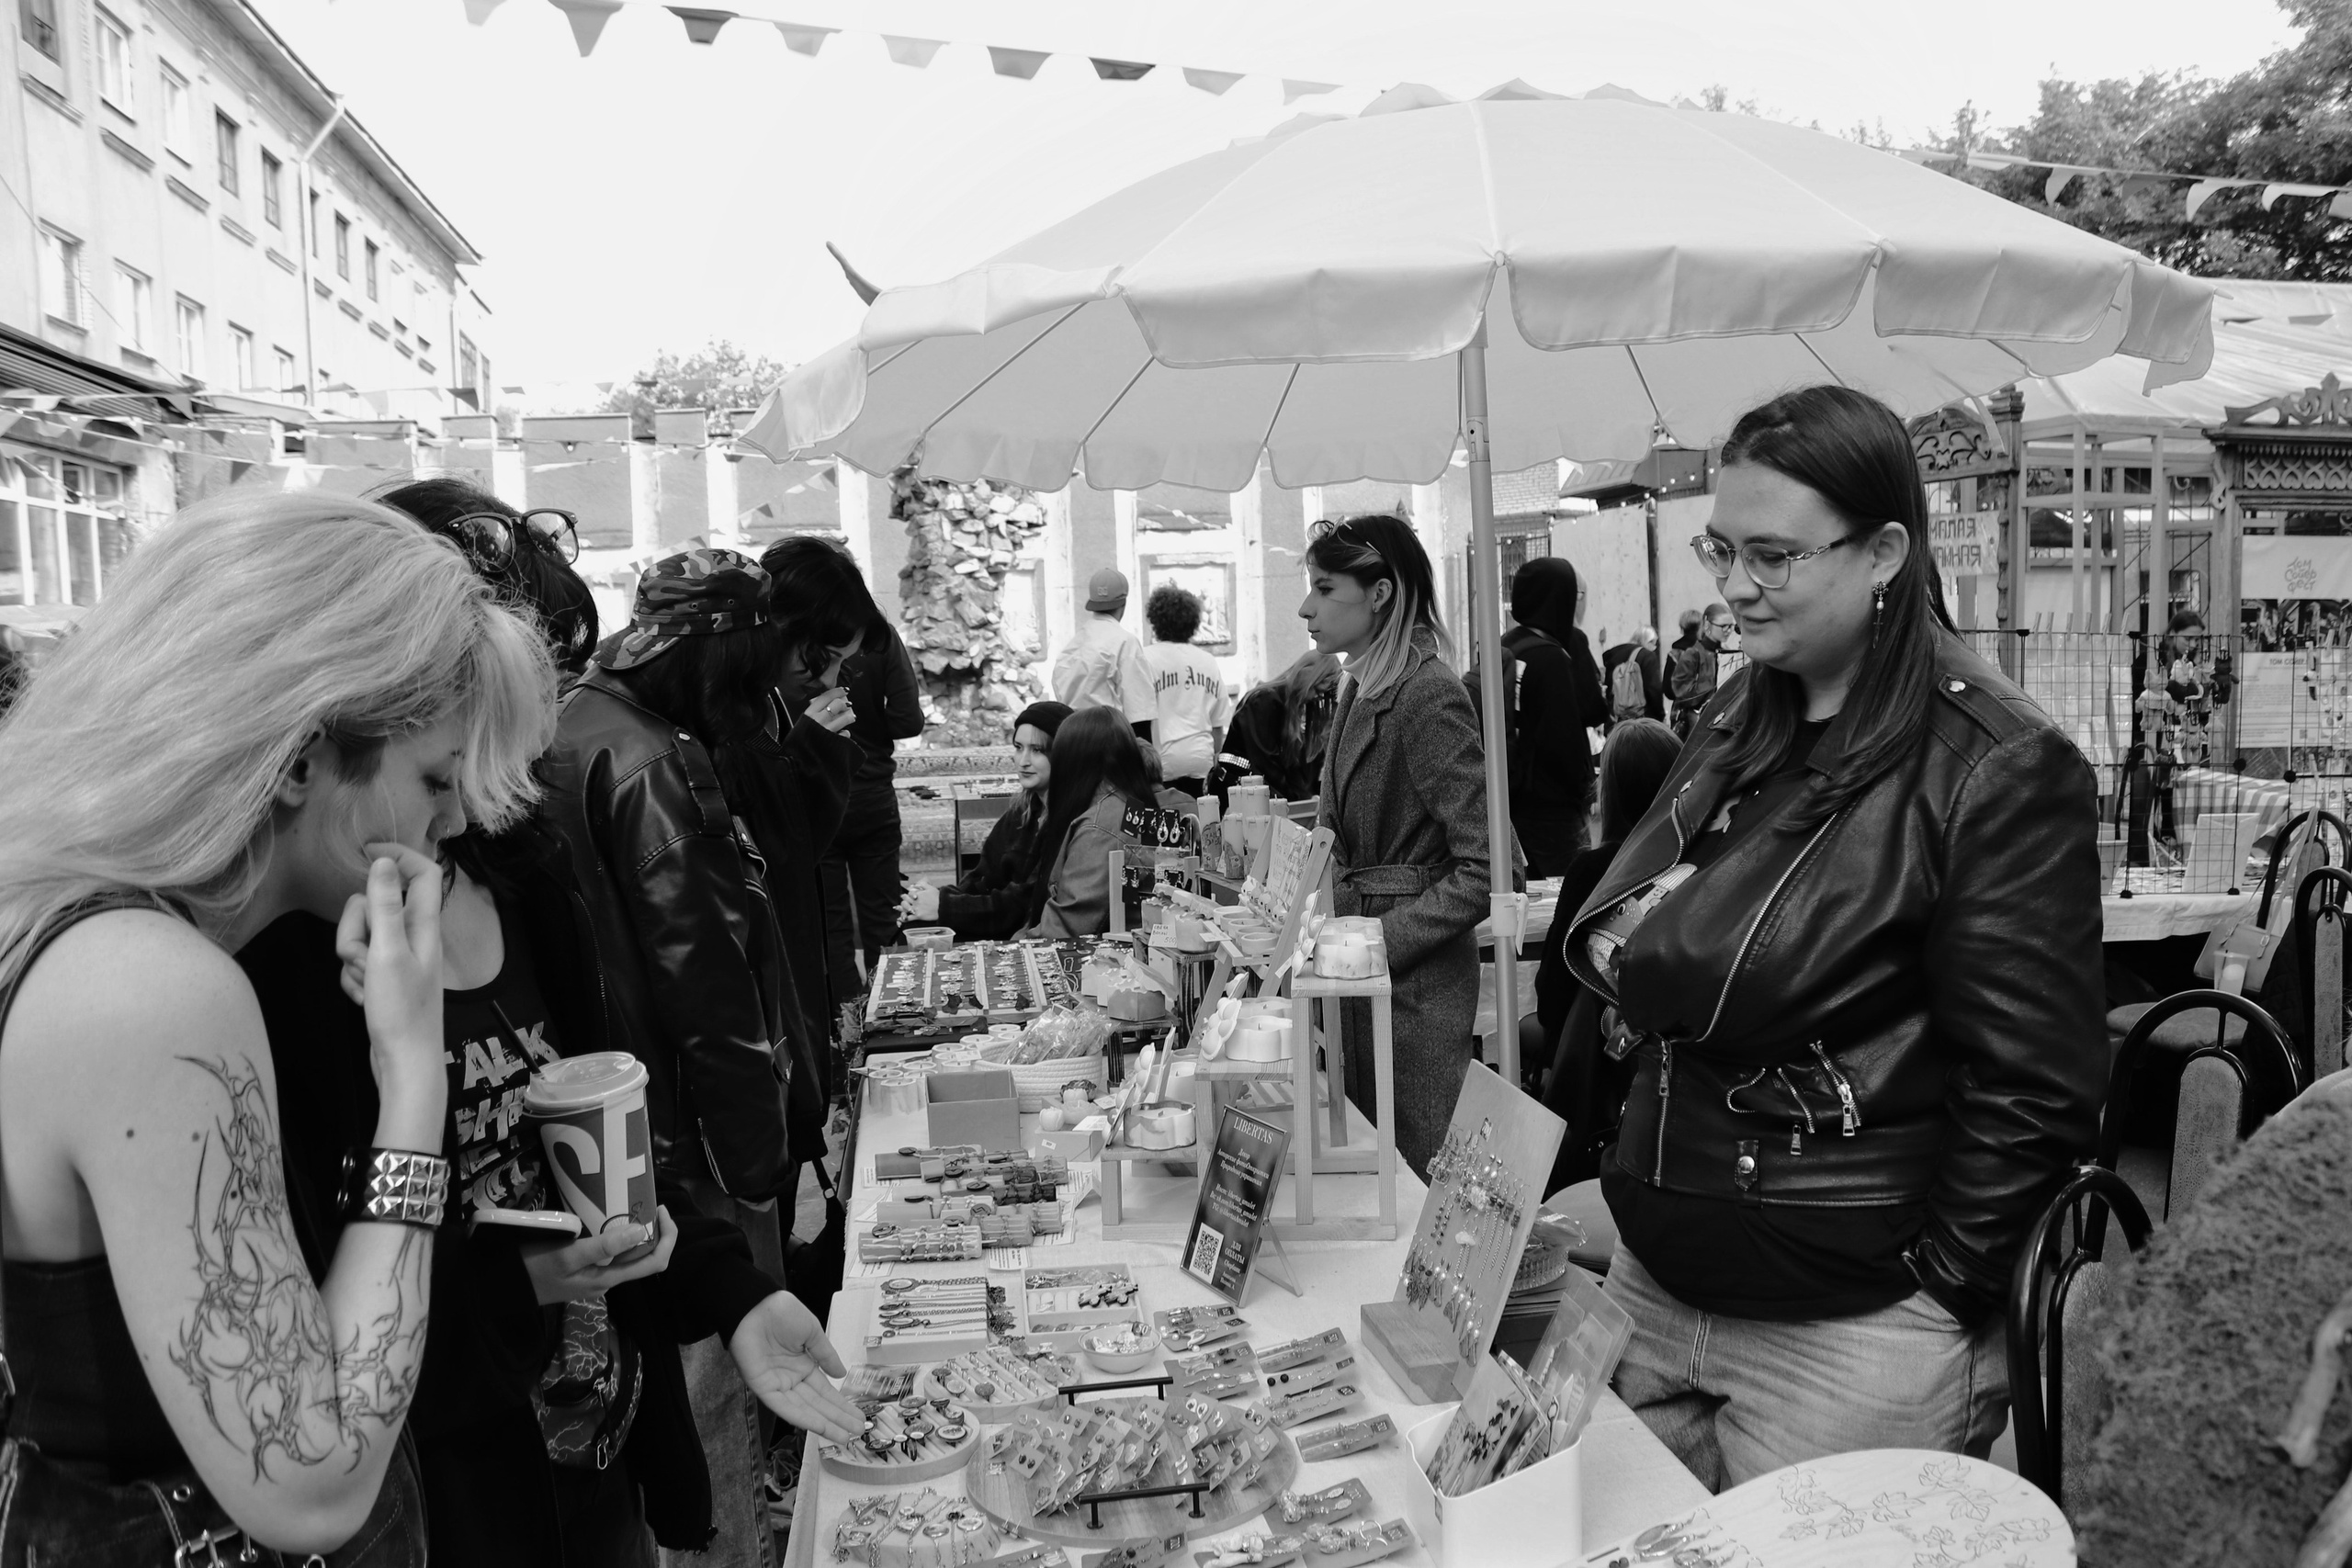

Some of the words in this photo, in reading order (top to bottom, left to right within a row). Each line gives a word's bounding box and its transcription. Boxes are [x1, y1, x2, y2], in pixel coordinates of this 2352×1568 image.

[1154, 670, 1179, 694] alm
[446, 1021, 560, 1091] ALK
[1234, 1116, 1273, 1145] LIBERTAS
